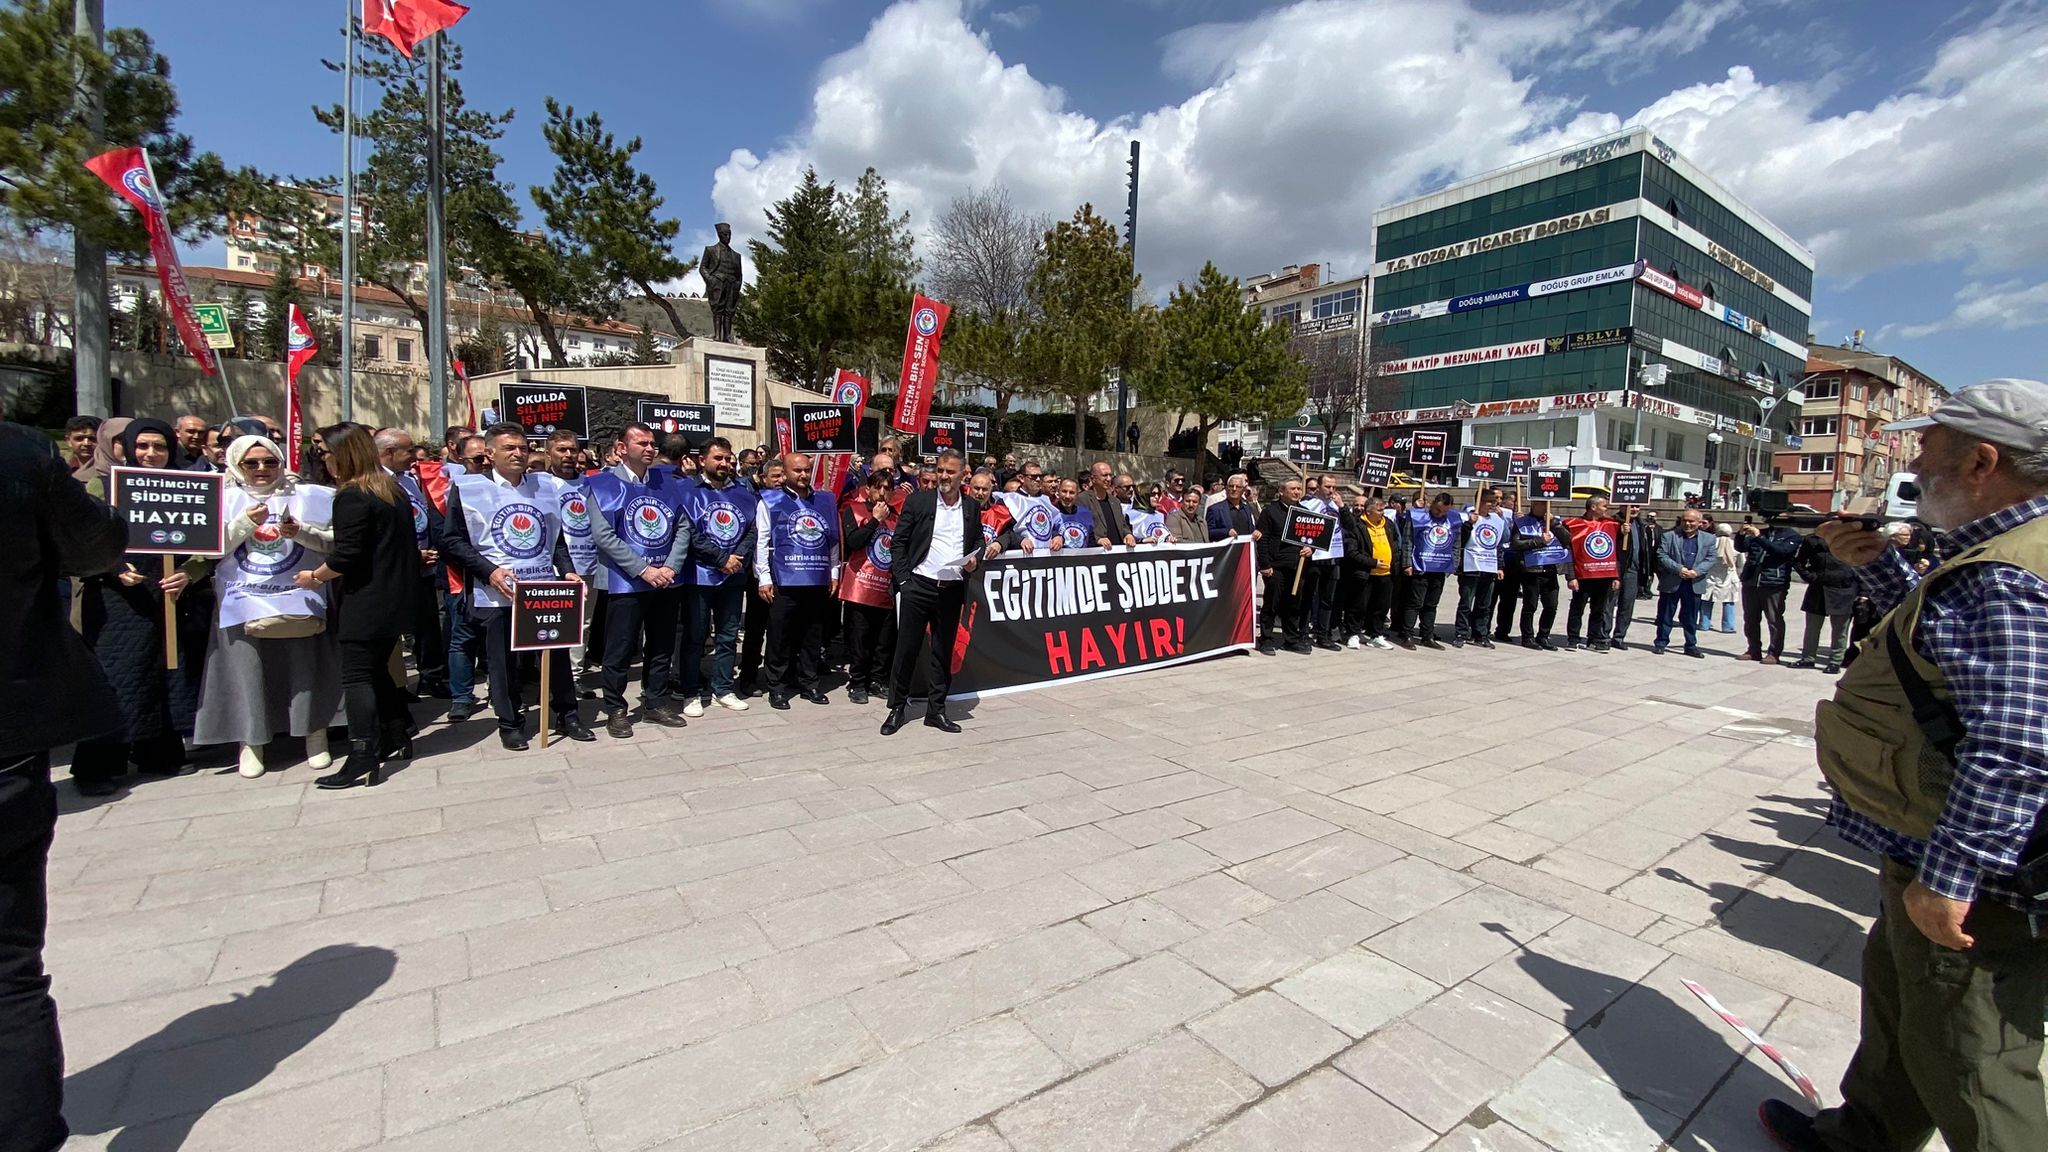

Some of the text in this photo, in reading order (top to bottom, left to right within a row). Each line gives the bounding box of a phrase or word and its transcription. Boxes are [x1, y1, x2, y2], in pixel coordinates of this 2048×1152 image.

[1386, 208, 1611, 274] T.C. YOZGAT TİCARET BORSASI
[1540, 267, 1626, 294] DOĞUŞ GRUP EMLAK
[1577, 328, 1622, 343] SELVİ
[1412, 356, 1440, 370] HATİP
[1444, 347, 1502, 365] MEZUNLARI
[1507, 342, 1541, 358] VAKFI
[900, 335, 925, 424] EĞİTİM-BİR-SEN
[516, 391, 566, 405] OKULDA
[1554, 391, 1610, 408] BURCU
[516, 401, 568, 417] SİLAHIN
[654, 407, 701, 420] BU GİDİŞE
[804, 408, 841, 422] OKULDA
[521, 411, 564, 427] İŞİ NE?
[803, 418, 843, 432] SİLAHIN
[930, 421, 956, 430] NEREYE
[679, 421, 711, 433] DİYELİM
[807, 427, 840, 441] İŞİ NE?
[938, 429, 948, 437] BU
[1472, 450, 1499, 459] NEREYE
[1366, 468, 1388, 479] HAYIR
[126, 478, 209, 491] EĞİTİMCİYE
[1616, 487, 1646, 495] HAYIR
[130, 490, 206, 505] ŞİDDETE
[129, 509, 208, 526] HAYIR
[1296, 516, 1325, 525] OKULDA
[525, 588, 575, 597] YÜREĞİMİZ
[983, 556, 1219, 622] EĞİTİMDE ŞİDDETE
[523, 600, 574, 609] YANGIN
[535, 613, 562, 623] YERİ
[1044, 616, 1185, 675] HAYIR!
